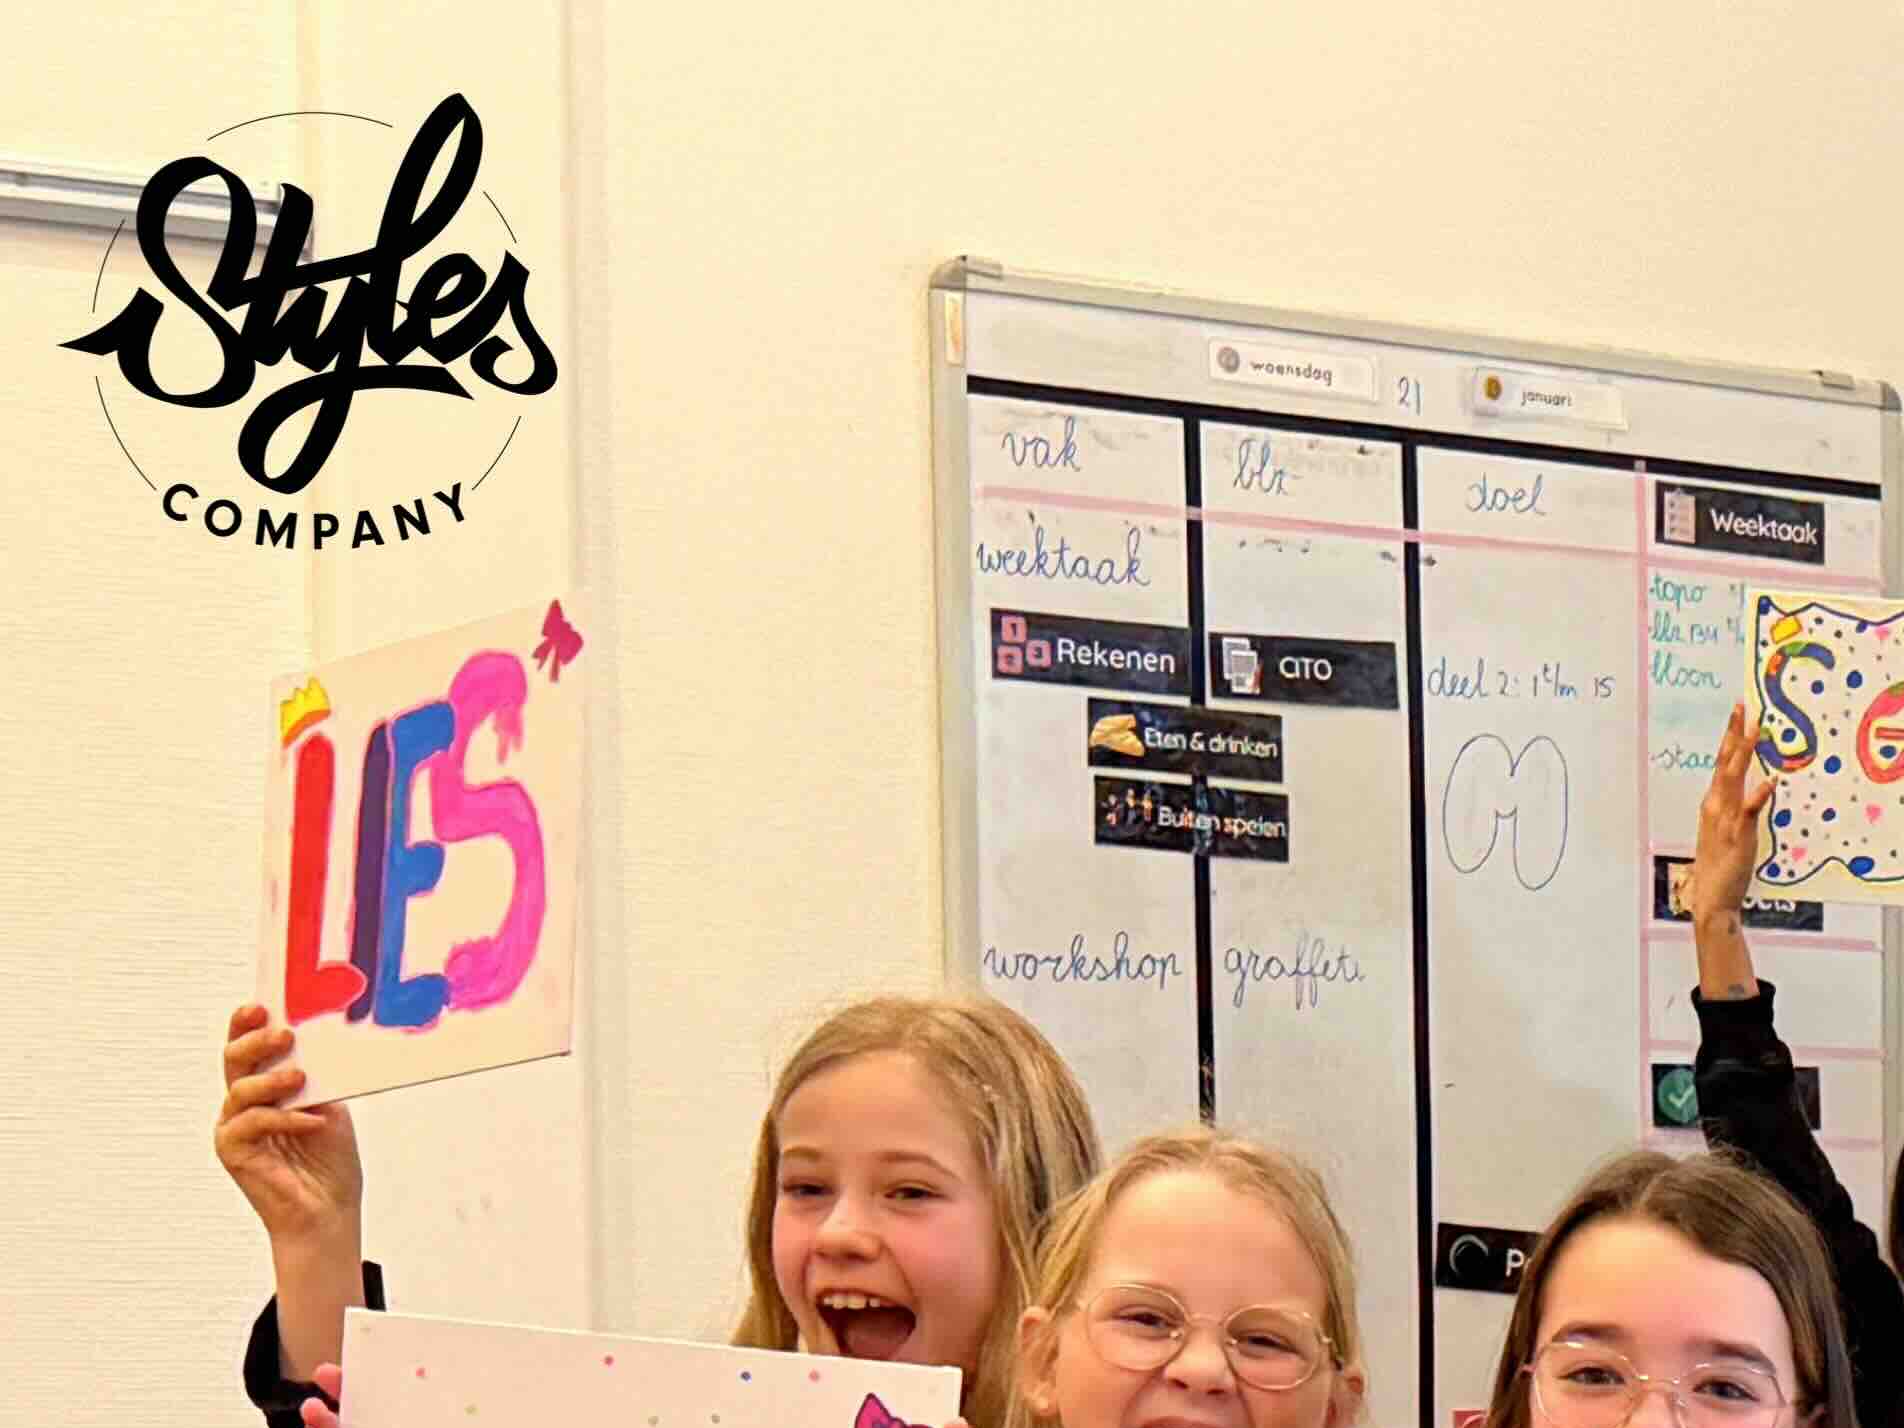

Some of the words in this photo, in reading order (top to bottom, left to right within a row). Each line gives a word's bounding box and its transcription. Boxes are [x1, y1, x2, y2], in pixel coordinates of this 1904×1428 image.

[1251, 358, 1333, 386] woensdag
[1521, 389, 1573, 409] januari
[1001, 416, 1081, 472] vak
[1710, 508, 1818, 546] Weektaak
[976, 527, 1151, 587] weektaak
[1057, 638, 1176, 675] Rekenen
[1278, 656, 1333, 681] CITO
[1427, 656, 1490, 698] deel
[1189, 732, 1206, 752] &
[1209, 734, 1278, 759] drinken
[1157, 807, 1220, 832] Buiten
[983, 931, 1183, 990] workshop
